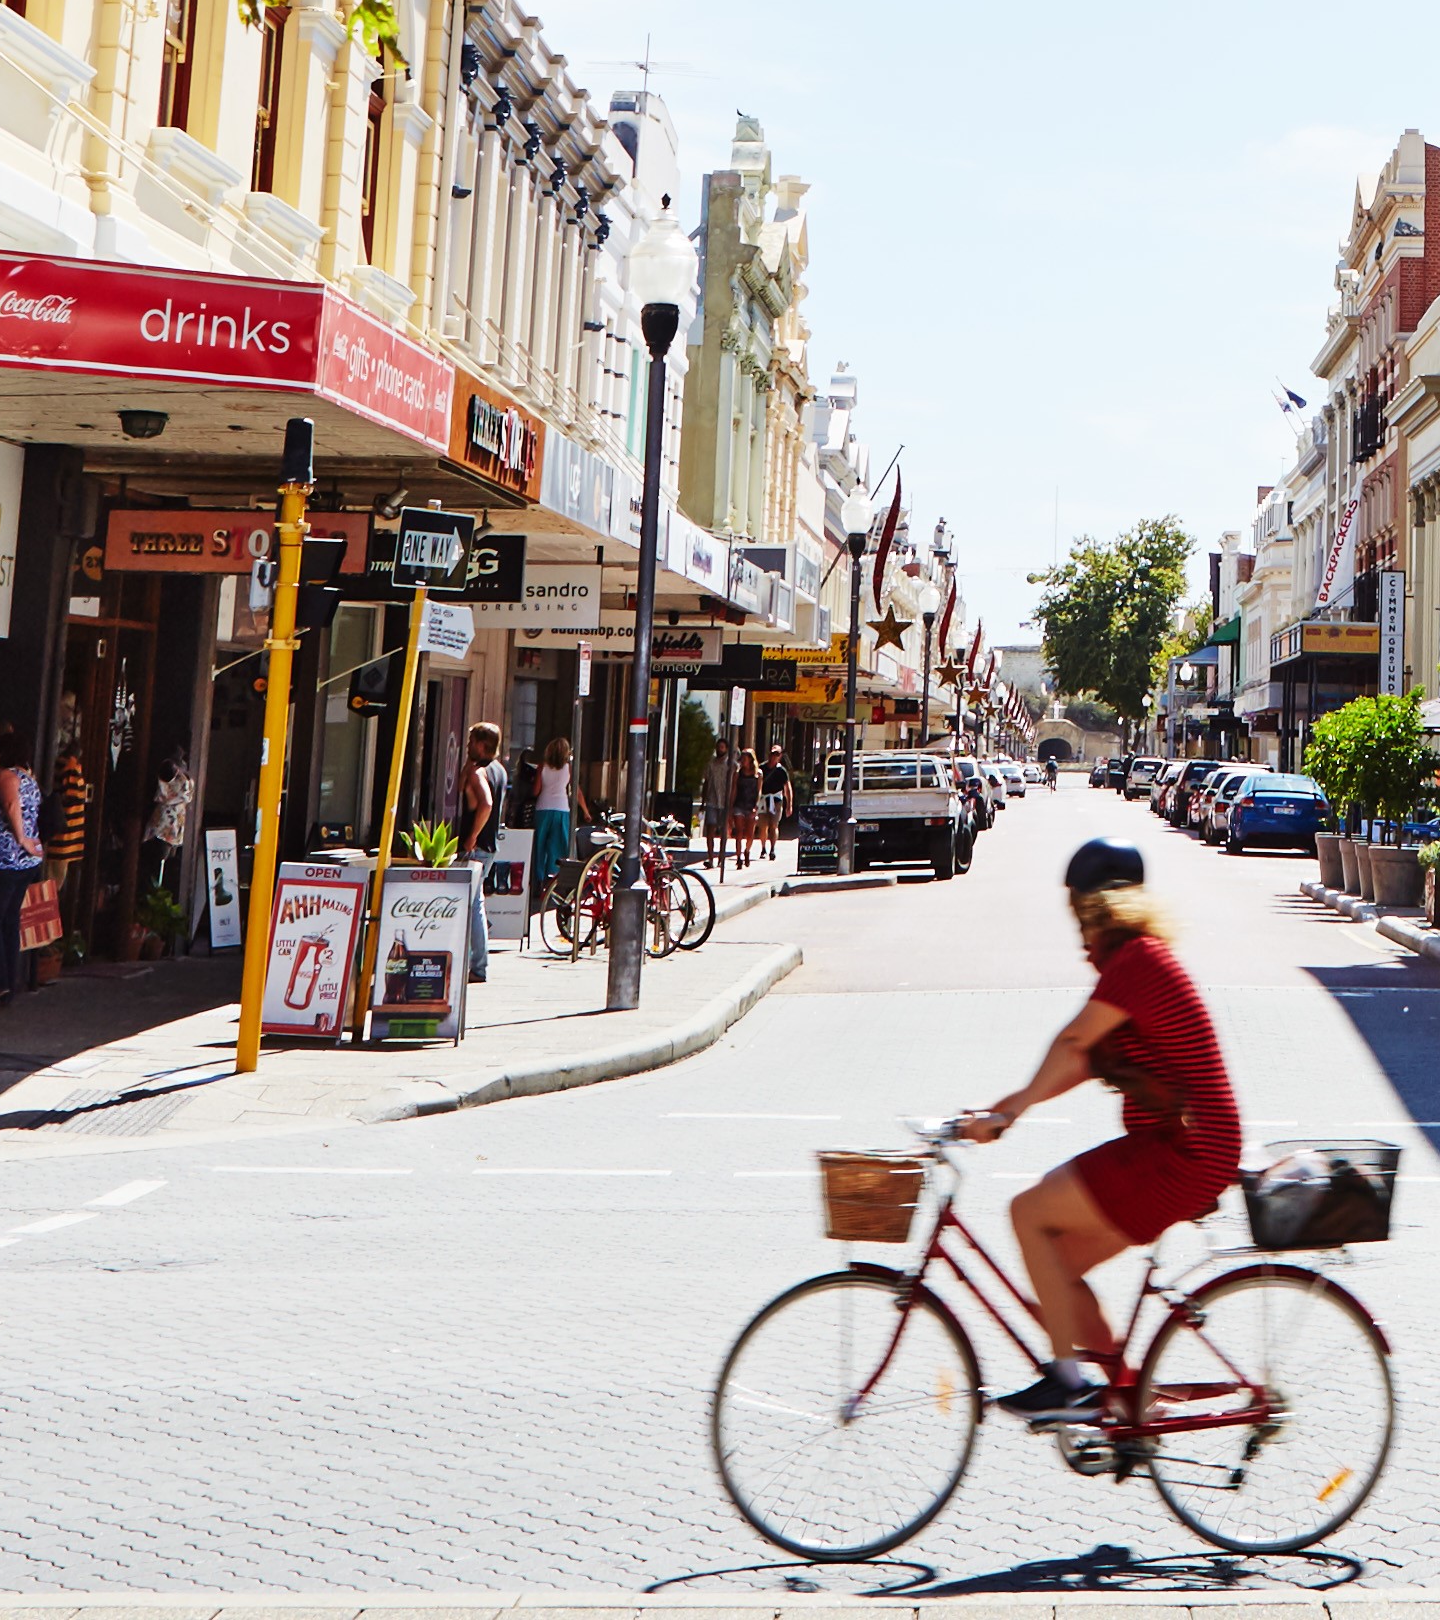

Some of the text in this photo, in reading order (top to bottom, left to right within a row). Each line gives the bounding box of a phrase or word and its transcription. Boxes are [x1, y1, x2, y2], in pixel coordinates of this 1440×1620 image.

[138, 299, 292, 354] drinks
[347, 337, 370, 382] gifts
[374, 352, 403, 400] phone
[403, 372, 426, 411] cards
[129, 531, 205, 554] THREE
[402, 534, 453, 566] ONE WAY
[1318, 499, 1359, 603] BACKPACKERS
[525, 582, 590, 598] sandro
[304, 867, 342, 879] OPEN
[410, 870, 448, 881] OPEN
[391, 895, 462, 919] Coca-Cola
[414, 920, 441, 940] life
[275, 939, 296, 948] LITTLE
[278, 948, 291, 956] CAN
[319, 983, 338, 991] LITTLE
